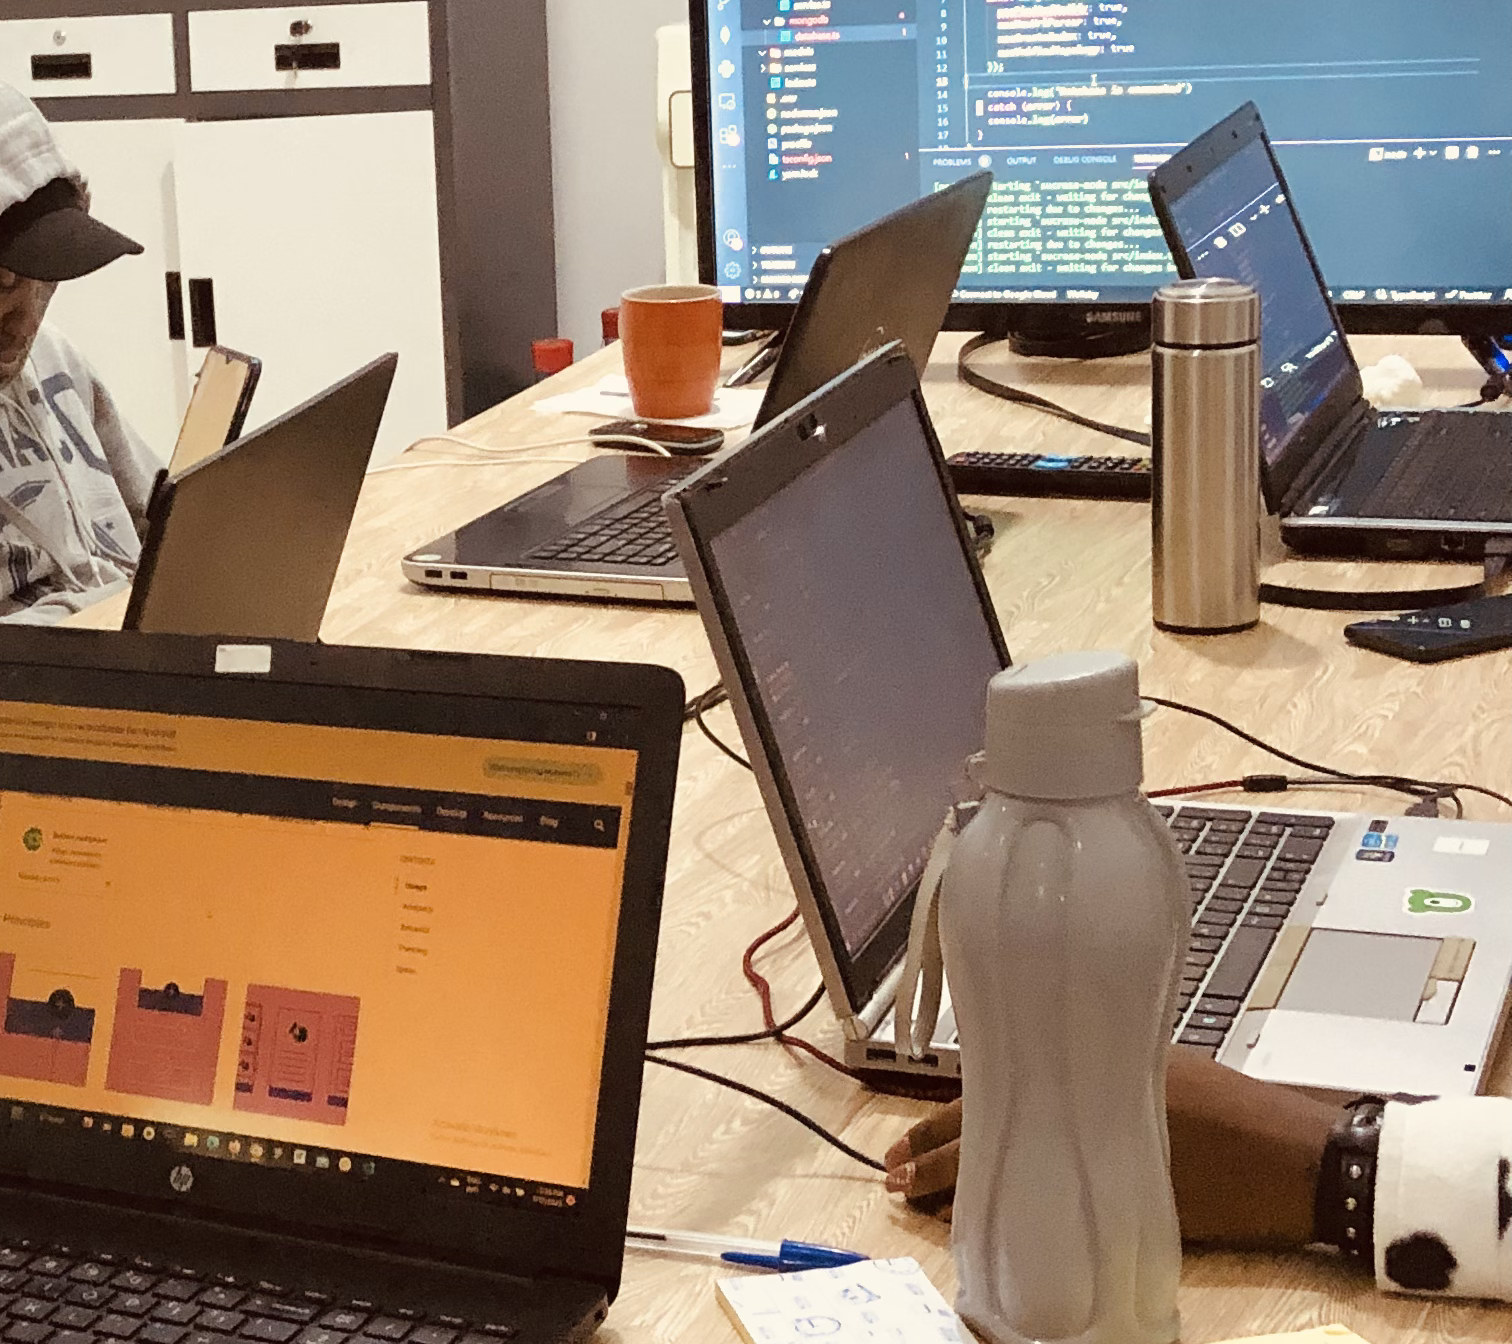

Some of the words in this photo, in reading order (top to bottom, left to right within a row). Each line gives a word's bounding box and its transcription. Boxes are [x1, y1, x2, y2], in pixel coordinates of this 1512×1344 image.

[1099, 3, 1128, 14] true,
[1093, 17, 1122, 27] true,
[1088, 31, 1117, 41] true,
[1110, 44, 1135, 53] true
[933, 157, 972, 166] PROBLEMS
[1007, 156, 1037, 165] OUTPUT
[1081, 154, 1117, 163] CONSOLE
[992, 181, 1031, 192] tarting
[1087, 311, 1141, 323] SAMSUNG
